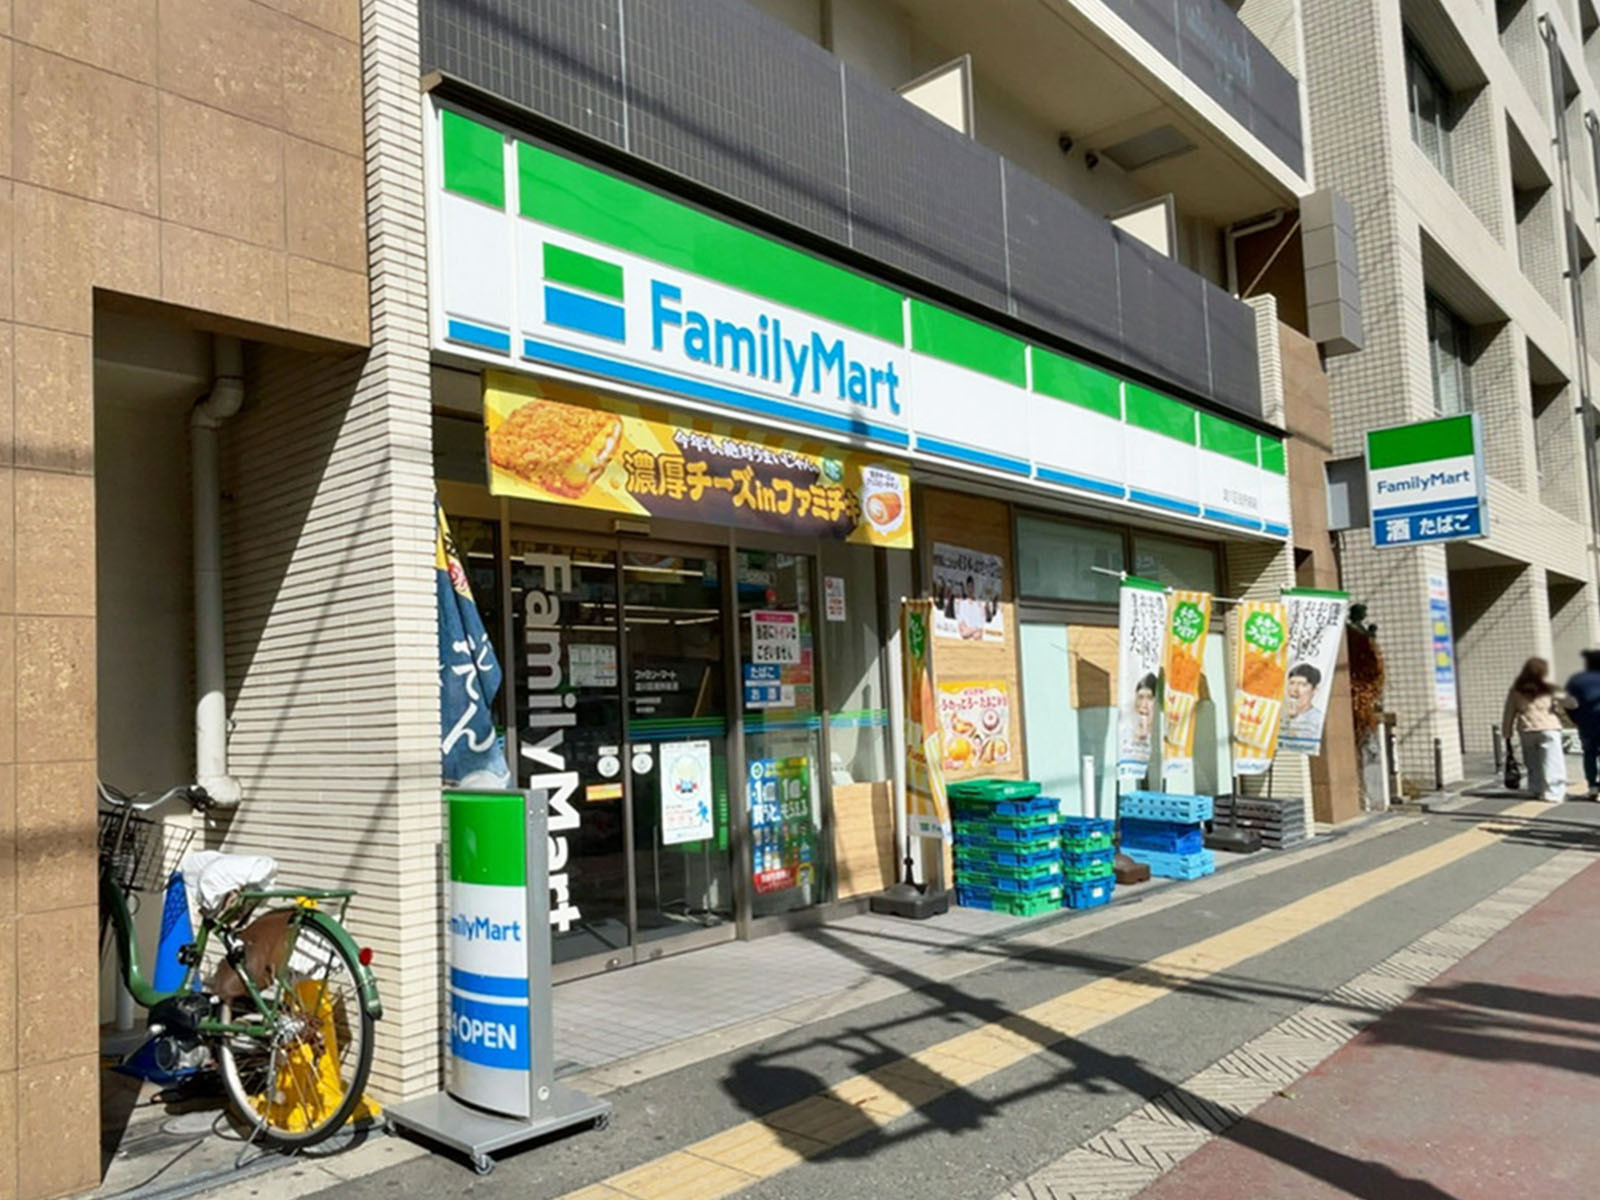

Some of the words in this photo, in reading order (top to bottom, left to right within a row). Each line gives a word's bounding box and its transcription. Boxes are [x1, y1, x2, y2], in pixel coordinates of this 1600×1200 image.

[651, 279, 901, 415] FamilyMart
[1376, 470, 1470, 494] FamilyMart
[1386, 518, 1410, 541] 酒
[1419, 514, 1470, 536] たばこ
[750, 666, 775, 679] たばこ
[521, 552, 582, 933] FamilyMart
